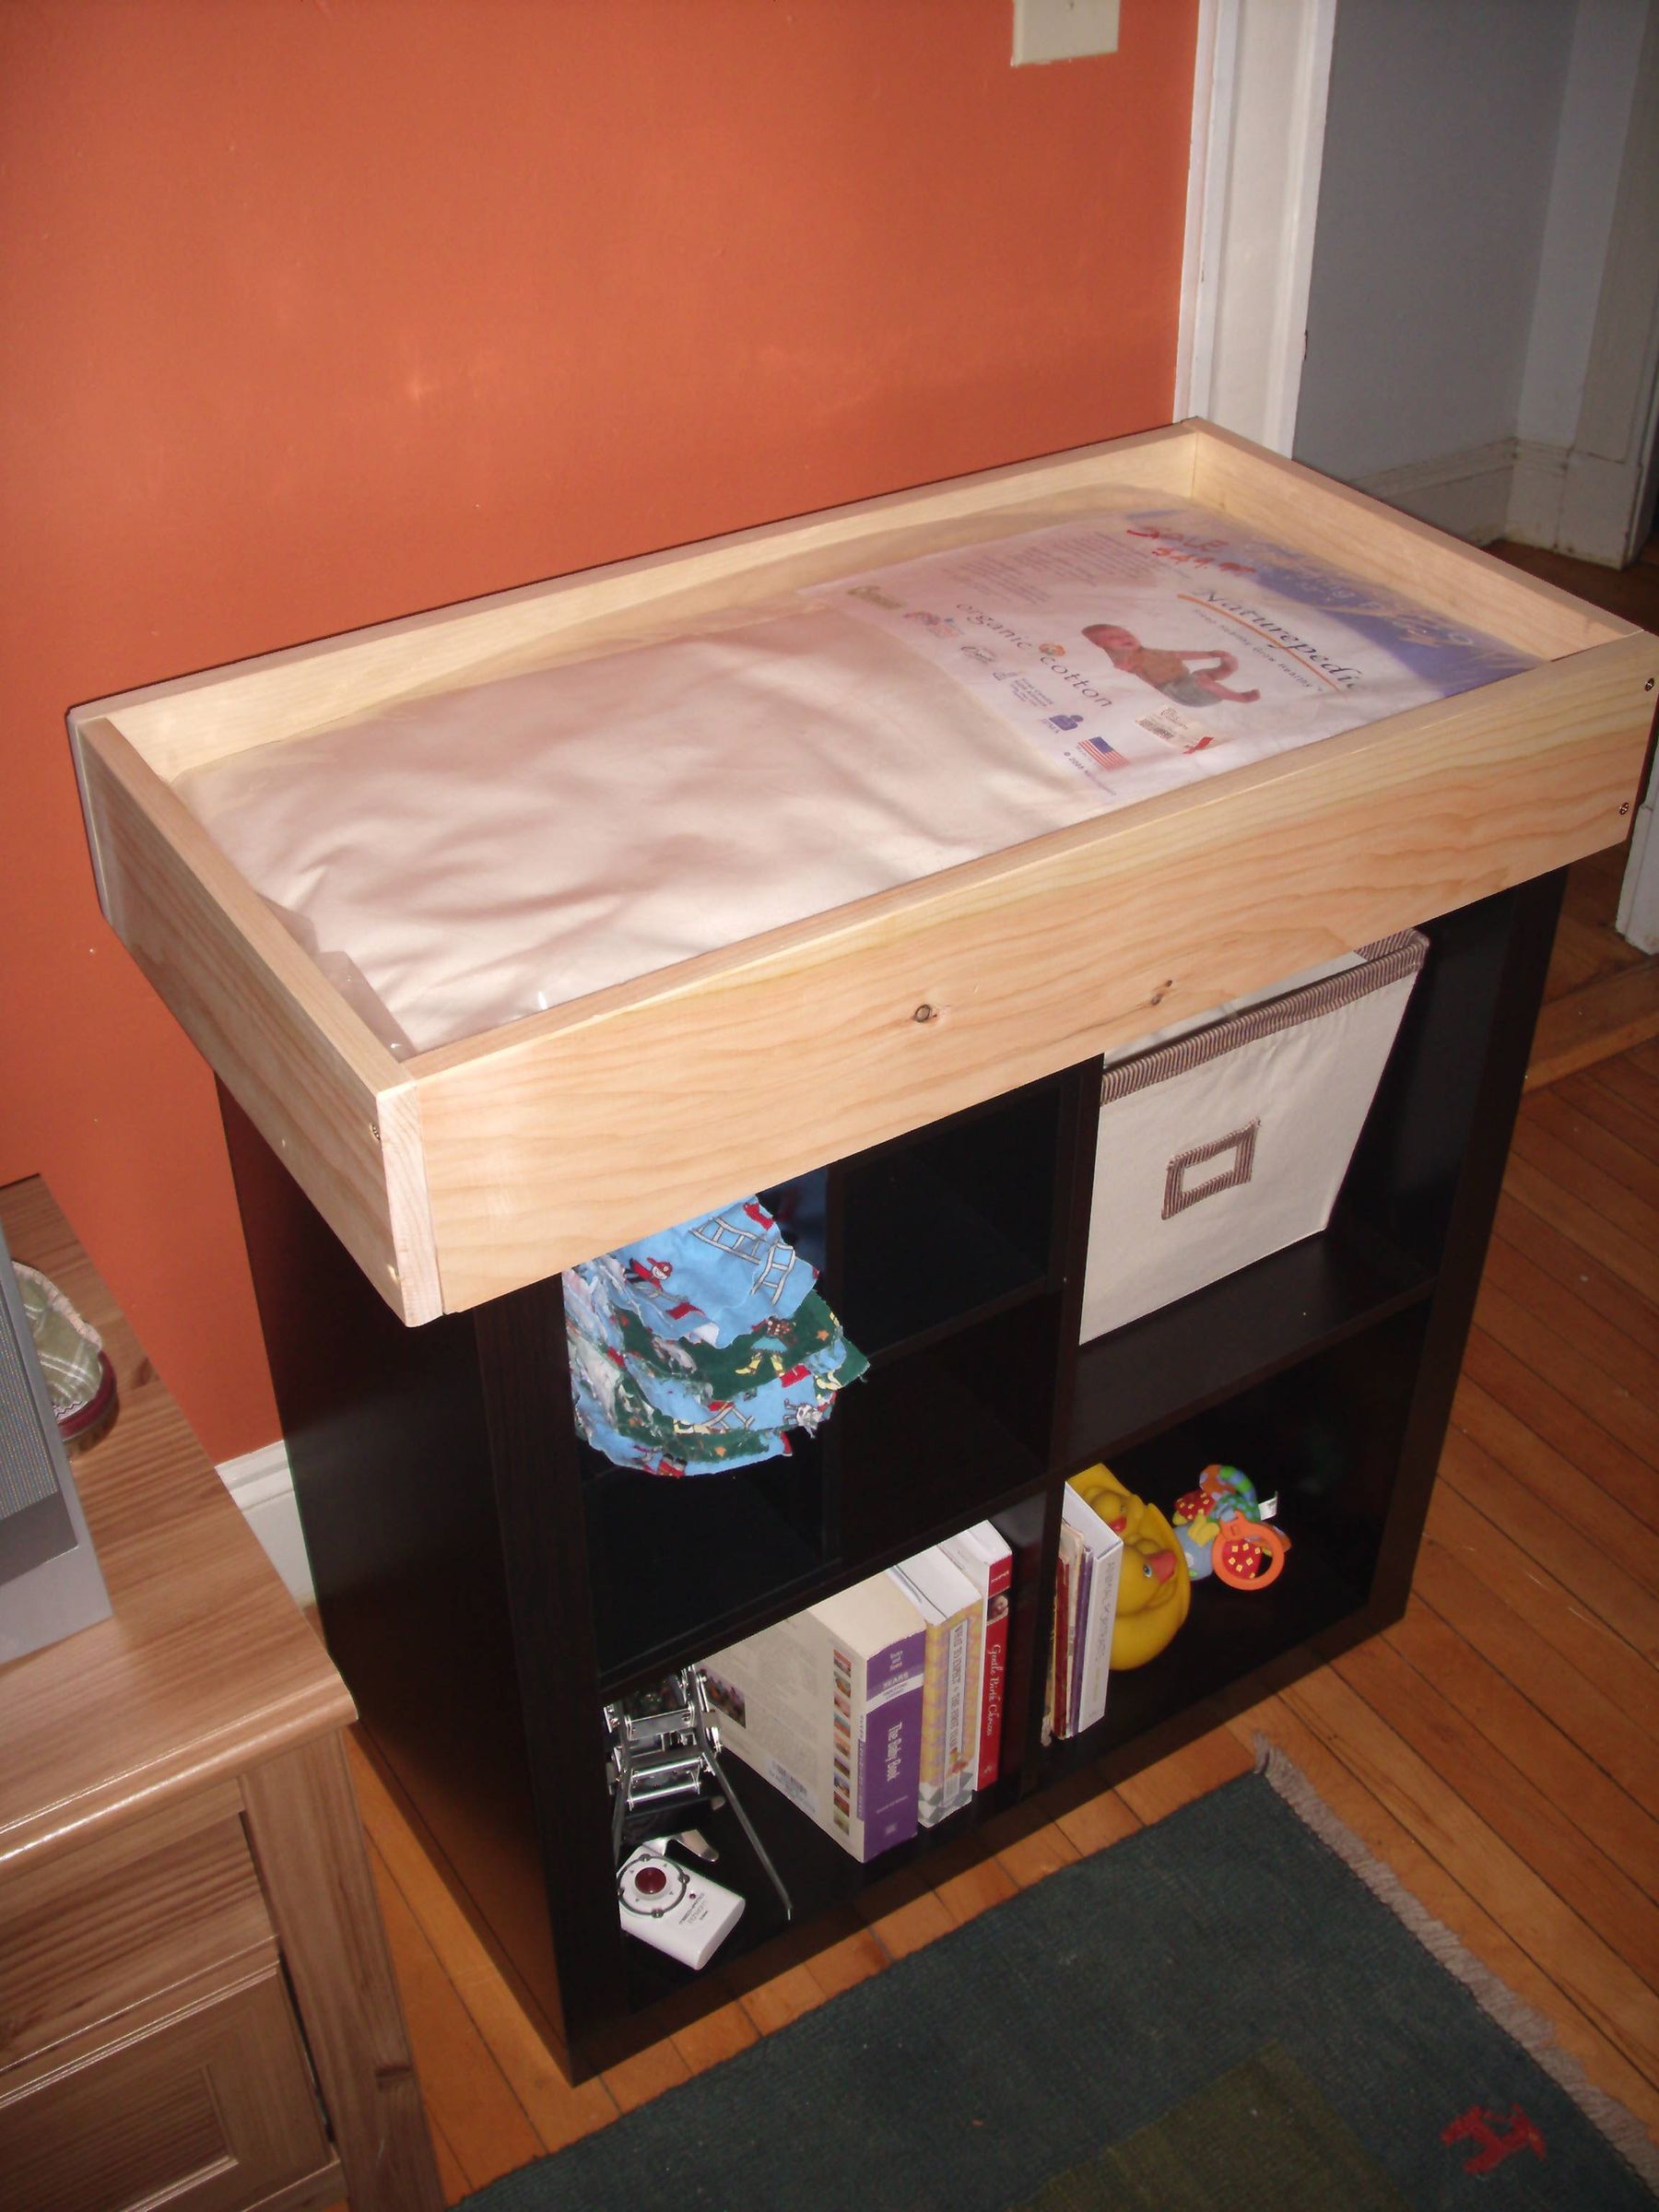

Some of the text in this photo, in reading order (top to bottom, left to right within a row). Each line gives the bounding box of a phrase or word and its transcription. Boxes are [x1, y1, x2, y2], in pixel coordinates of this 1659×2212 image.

[957, 604, 1032, 650] organic
[1040, 655, 1112, 708] cotton
[887, 1721, 902, 1741] The
[885, 1737, 902, 1763] Baby
[887, 1758, 901, 1783] Book
